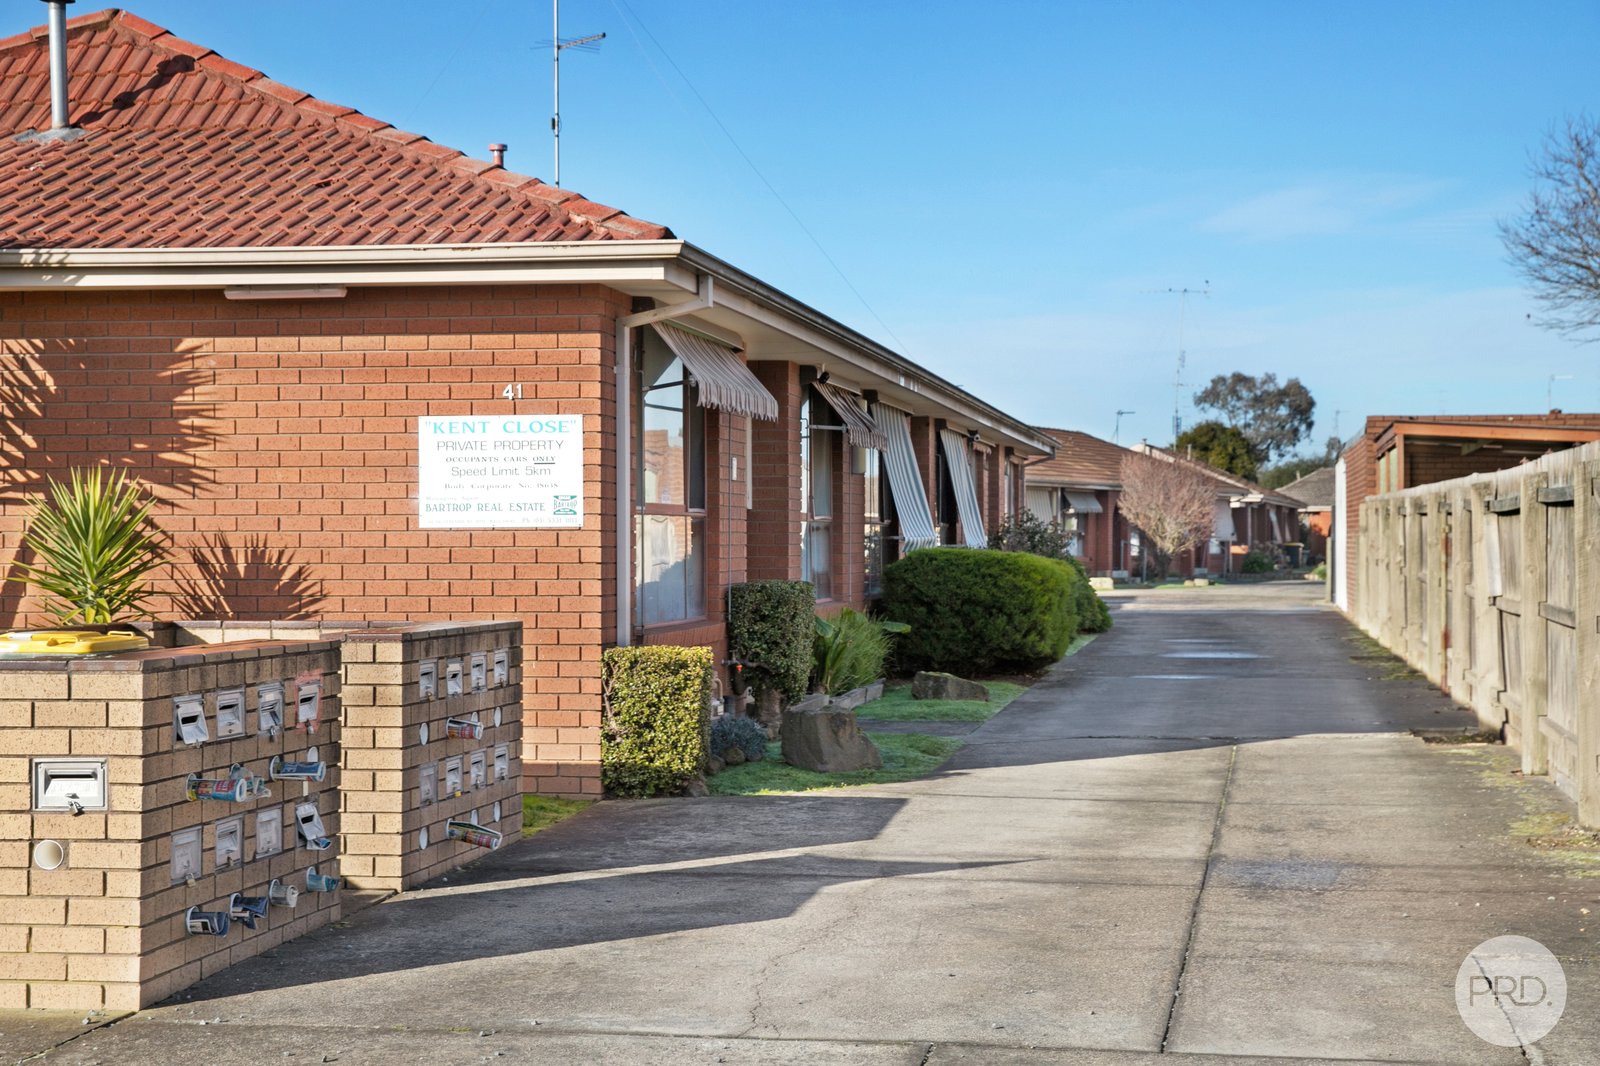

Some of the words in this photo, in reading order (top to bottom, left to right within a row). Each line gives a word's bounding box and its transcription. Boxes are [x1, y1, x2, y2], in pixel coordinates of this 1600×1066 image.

[502, 383, 523, 400] 41
[425, 420, 490, 434] "KENT
[502, 420, 577, 433] CLOSE"
[436, 440, 488, 451] PRIVATE
[493, 439, 565, 451] PROPERTY
[451, 466, 487, 478] Speed
[491, 466, 520, 476] Limit
[525, 466, 552, 476] 5km
[425, 502, 472, 513] BARTROP
[477, 502, 503, 512] REAL
[509, 502, 546, 512] ESTATE
